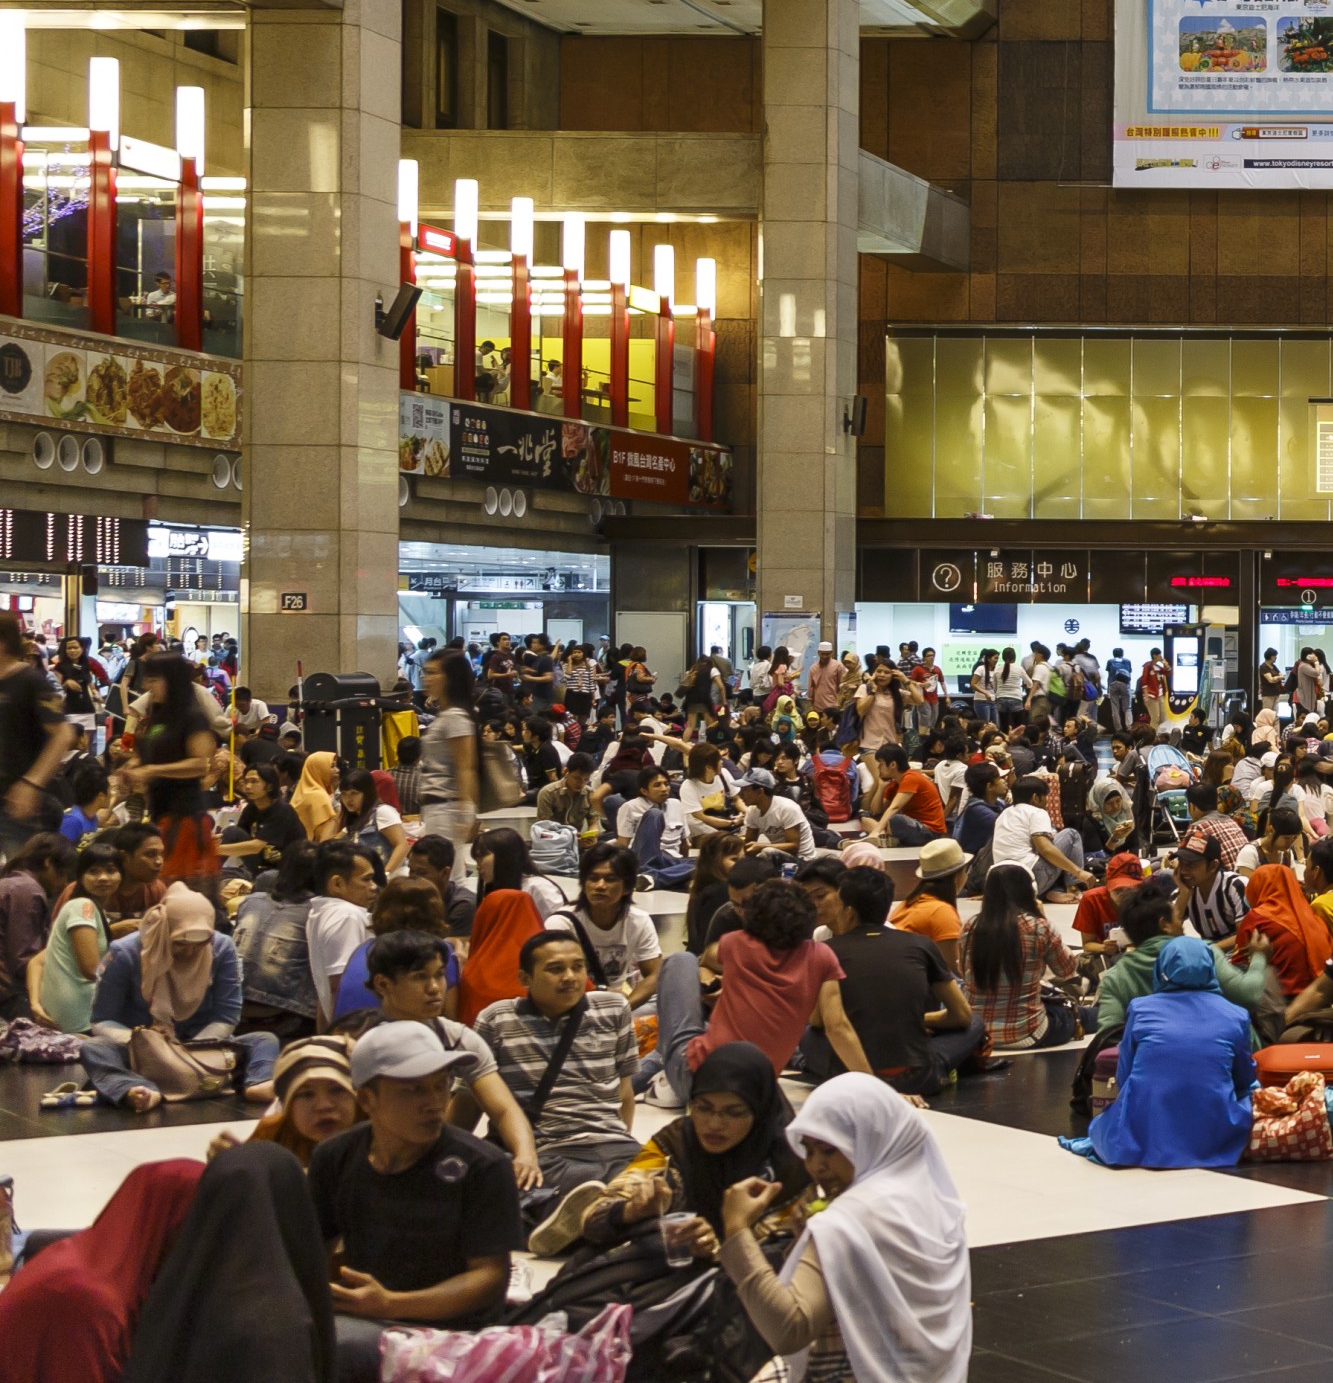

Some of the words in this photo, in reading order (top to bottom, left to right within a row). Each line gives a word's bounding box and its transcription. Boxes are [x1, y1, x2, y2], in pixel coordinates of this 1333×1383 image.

[987, 562, 1077, 578] 服務中心
[994, 582, 1067, 593] Information
[285, 595, 304, 609] F26
